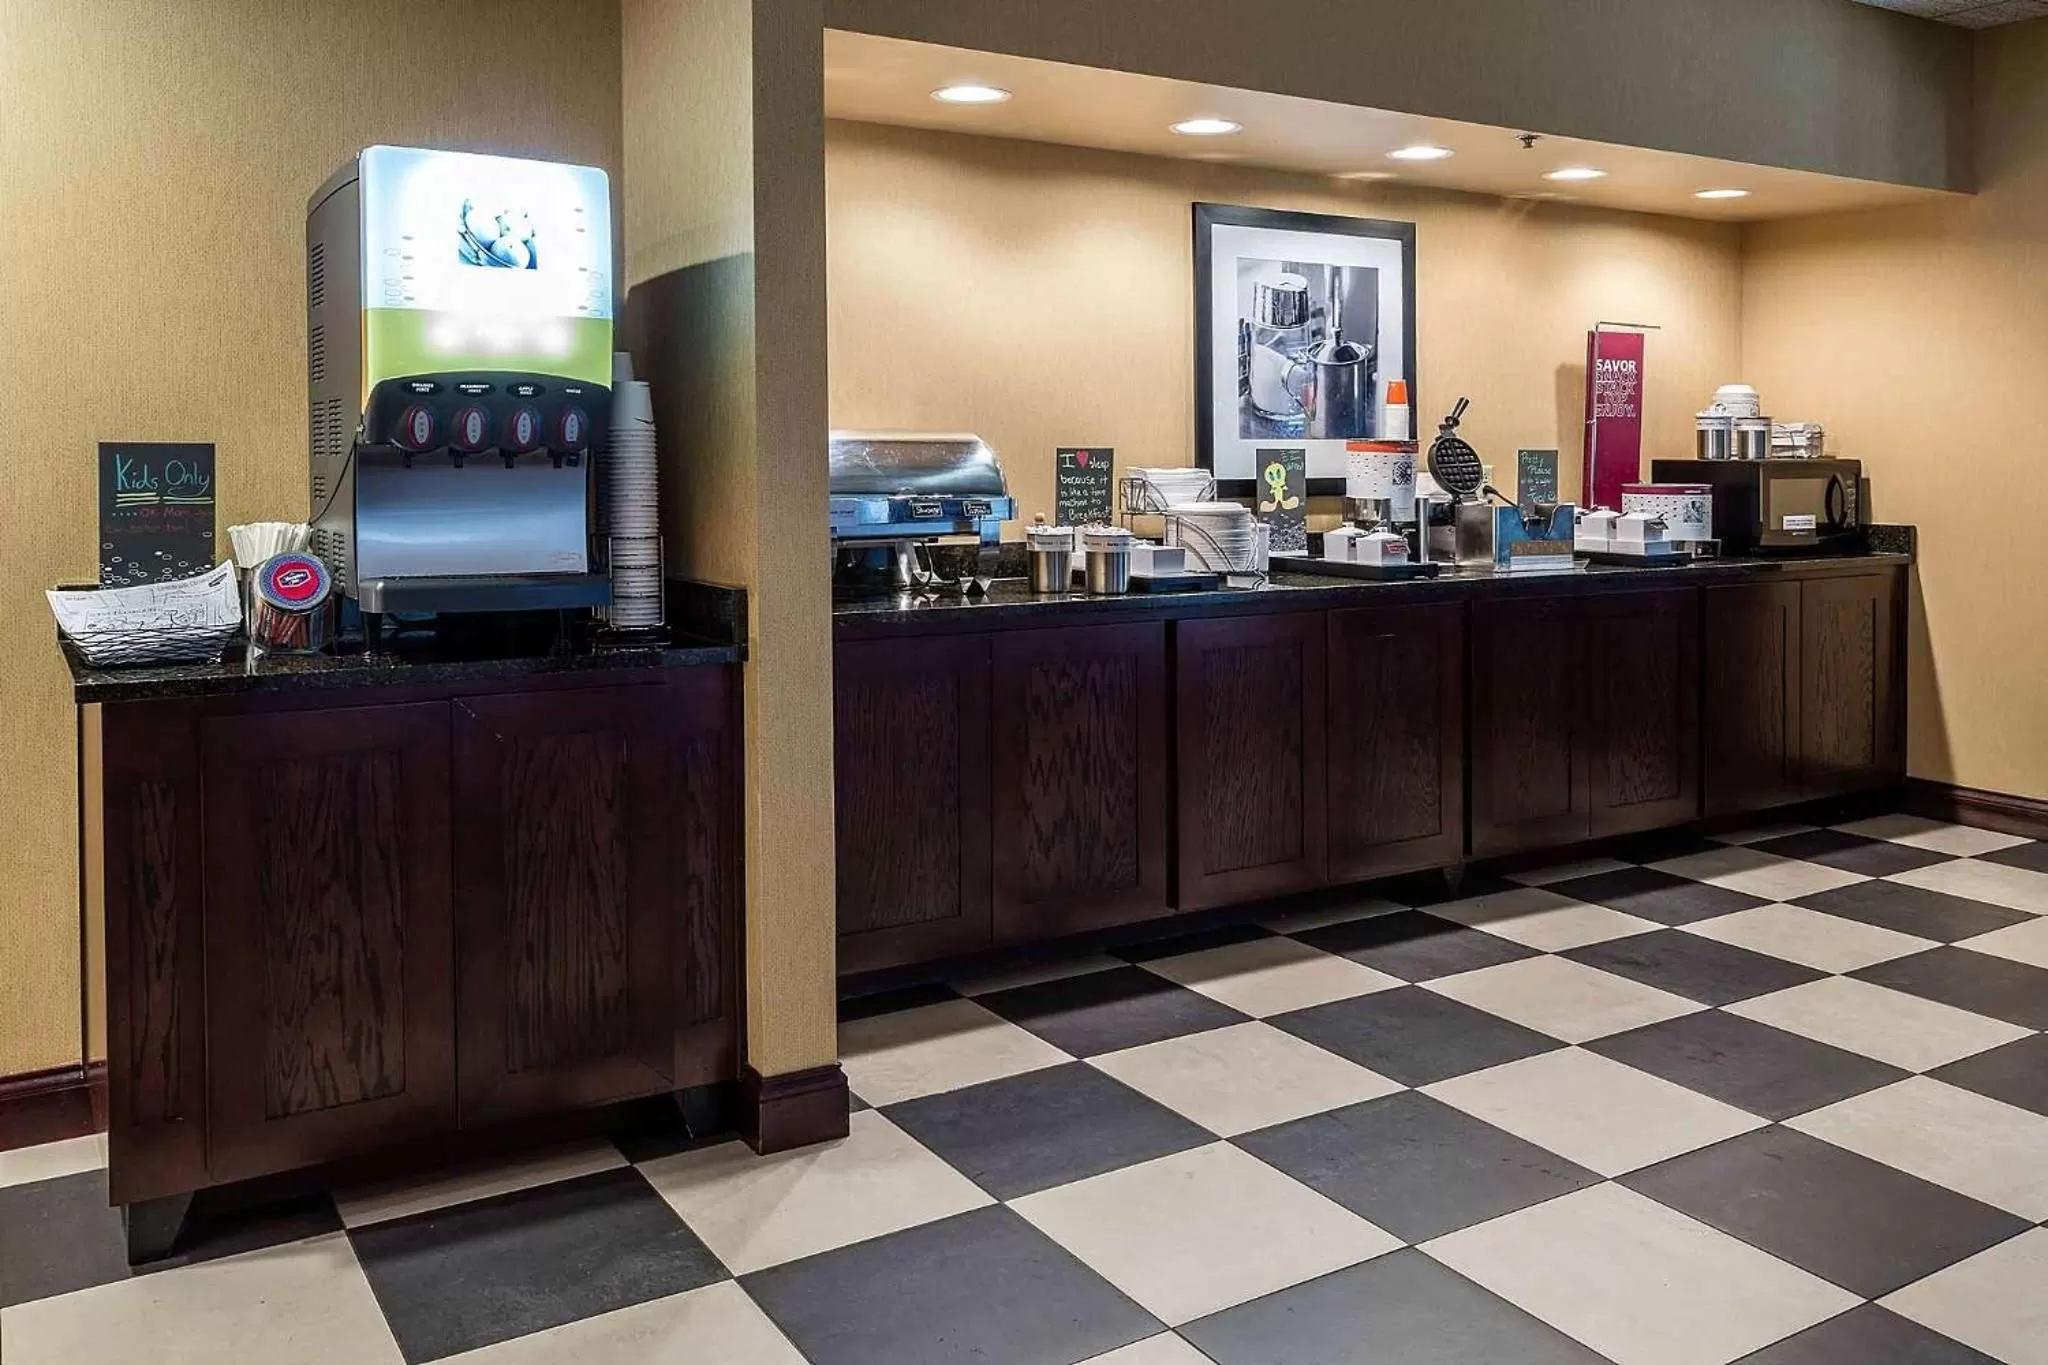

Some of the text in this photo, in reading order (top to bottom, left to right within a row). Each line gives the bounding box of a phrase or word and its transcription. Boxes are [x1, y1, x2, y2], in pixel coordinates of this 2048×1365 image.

[1596, 359, 1636, 372] SAVOR
[1059, 453, 1075, 468] I
[115, 453, 209, 498] Kids Only
[1060, 474, 1108, 485] because it
